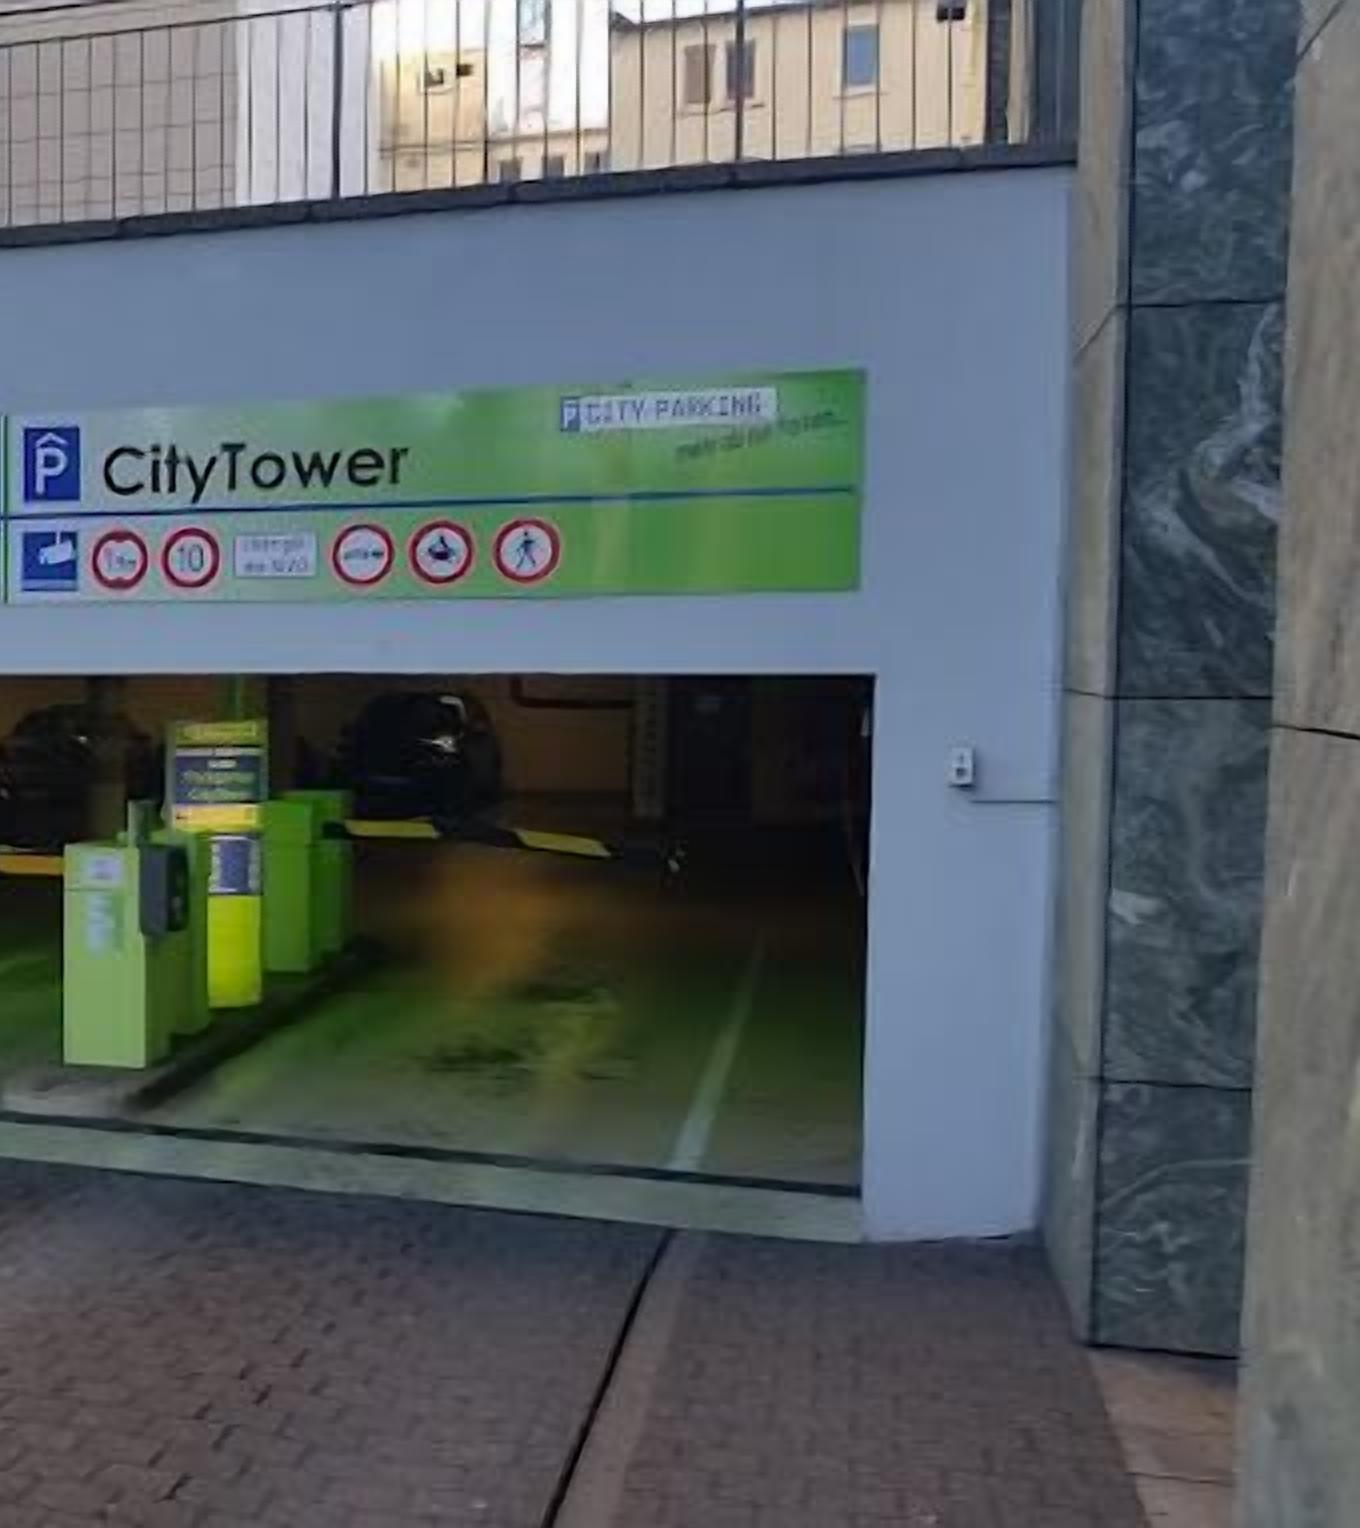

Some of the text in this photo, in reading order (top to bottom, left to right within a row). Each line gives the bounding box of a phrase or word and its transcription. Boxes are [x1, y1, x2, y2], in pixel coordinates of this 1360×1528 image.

[586, 398, 646, 425] CITY
[655, 391, 762, 420] PARKING
[36, 446, 69, 495] P
[103, 442, 409, 504] CityTower
[176, 543, 204, 573] 10
